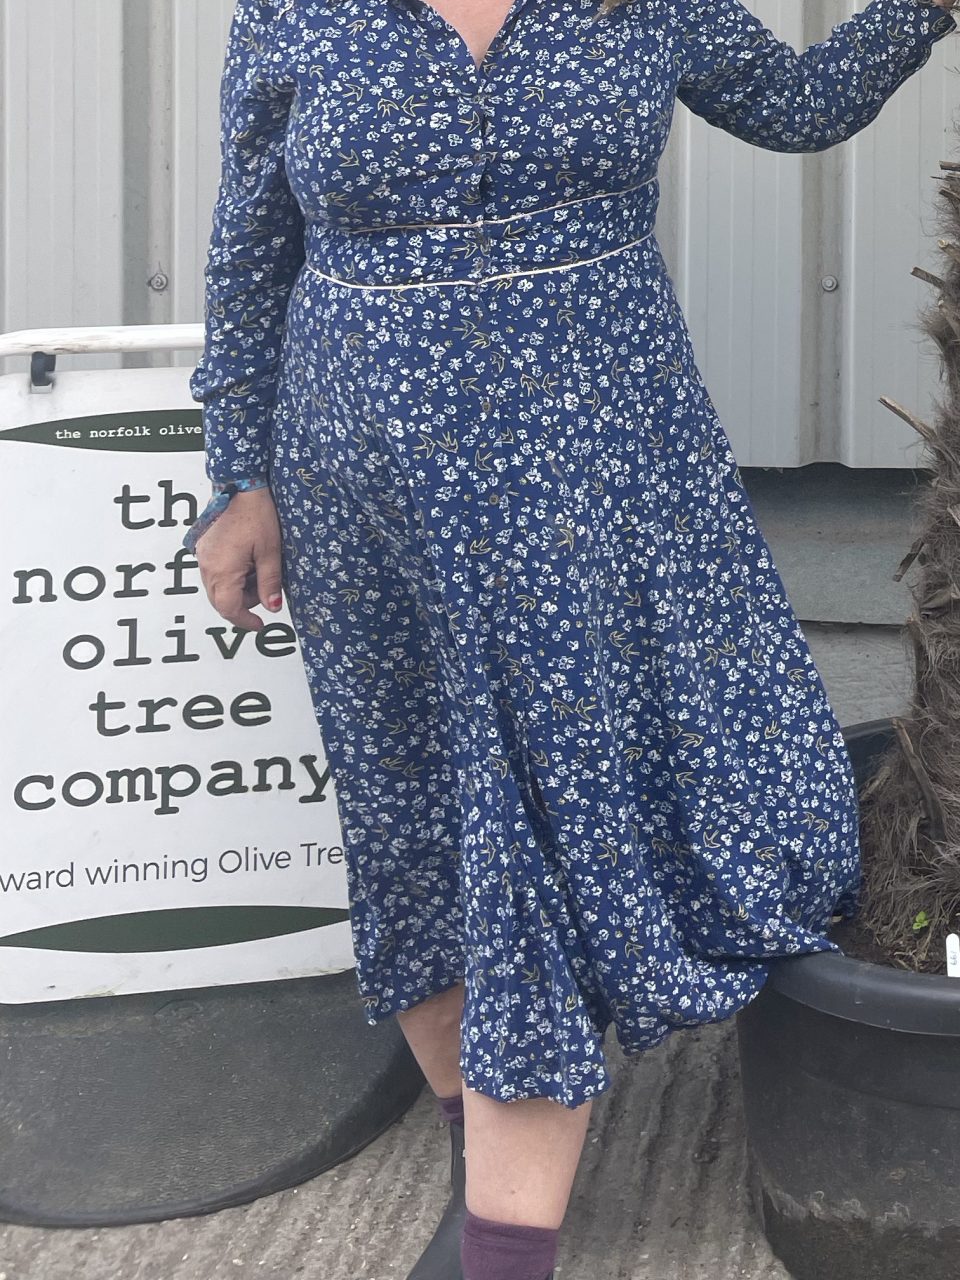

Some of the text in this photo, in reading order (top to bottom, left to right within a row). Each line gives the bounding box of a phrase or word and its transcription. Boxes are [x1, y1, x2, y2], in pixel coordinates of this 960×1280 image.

[55, 425, 202, 439] the norfolk olive
[113, 479, 198, 530] th
[12, 548, 199, 604] norf
[62, 615, 297, 670] olive
[88, 691, 272, 737] tree
[13, 754, 331, 816] company
[0, 842, 344, 892] ward winning Olive Tre
